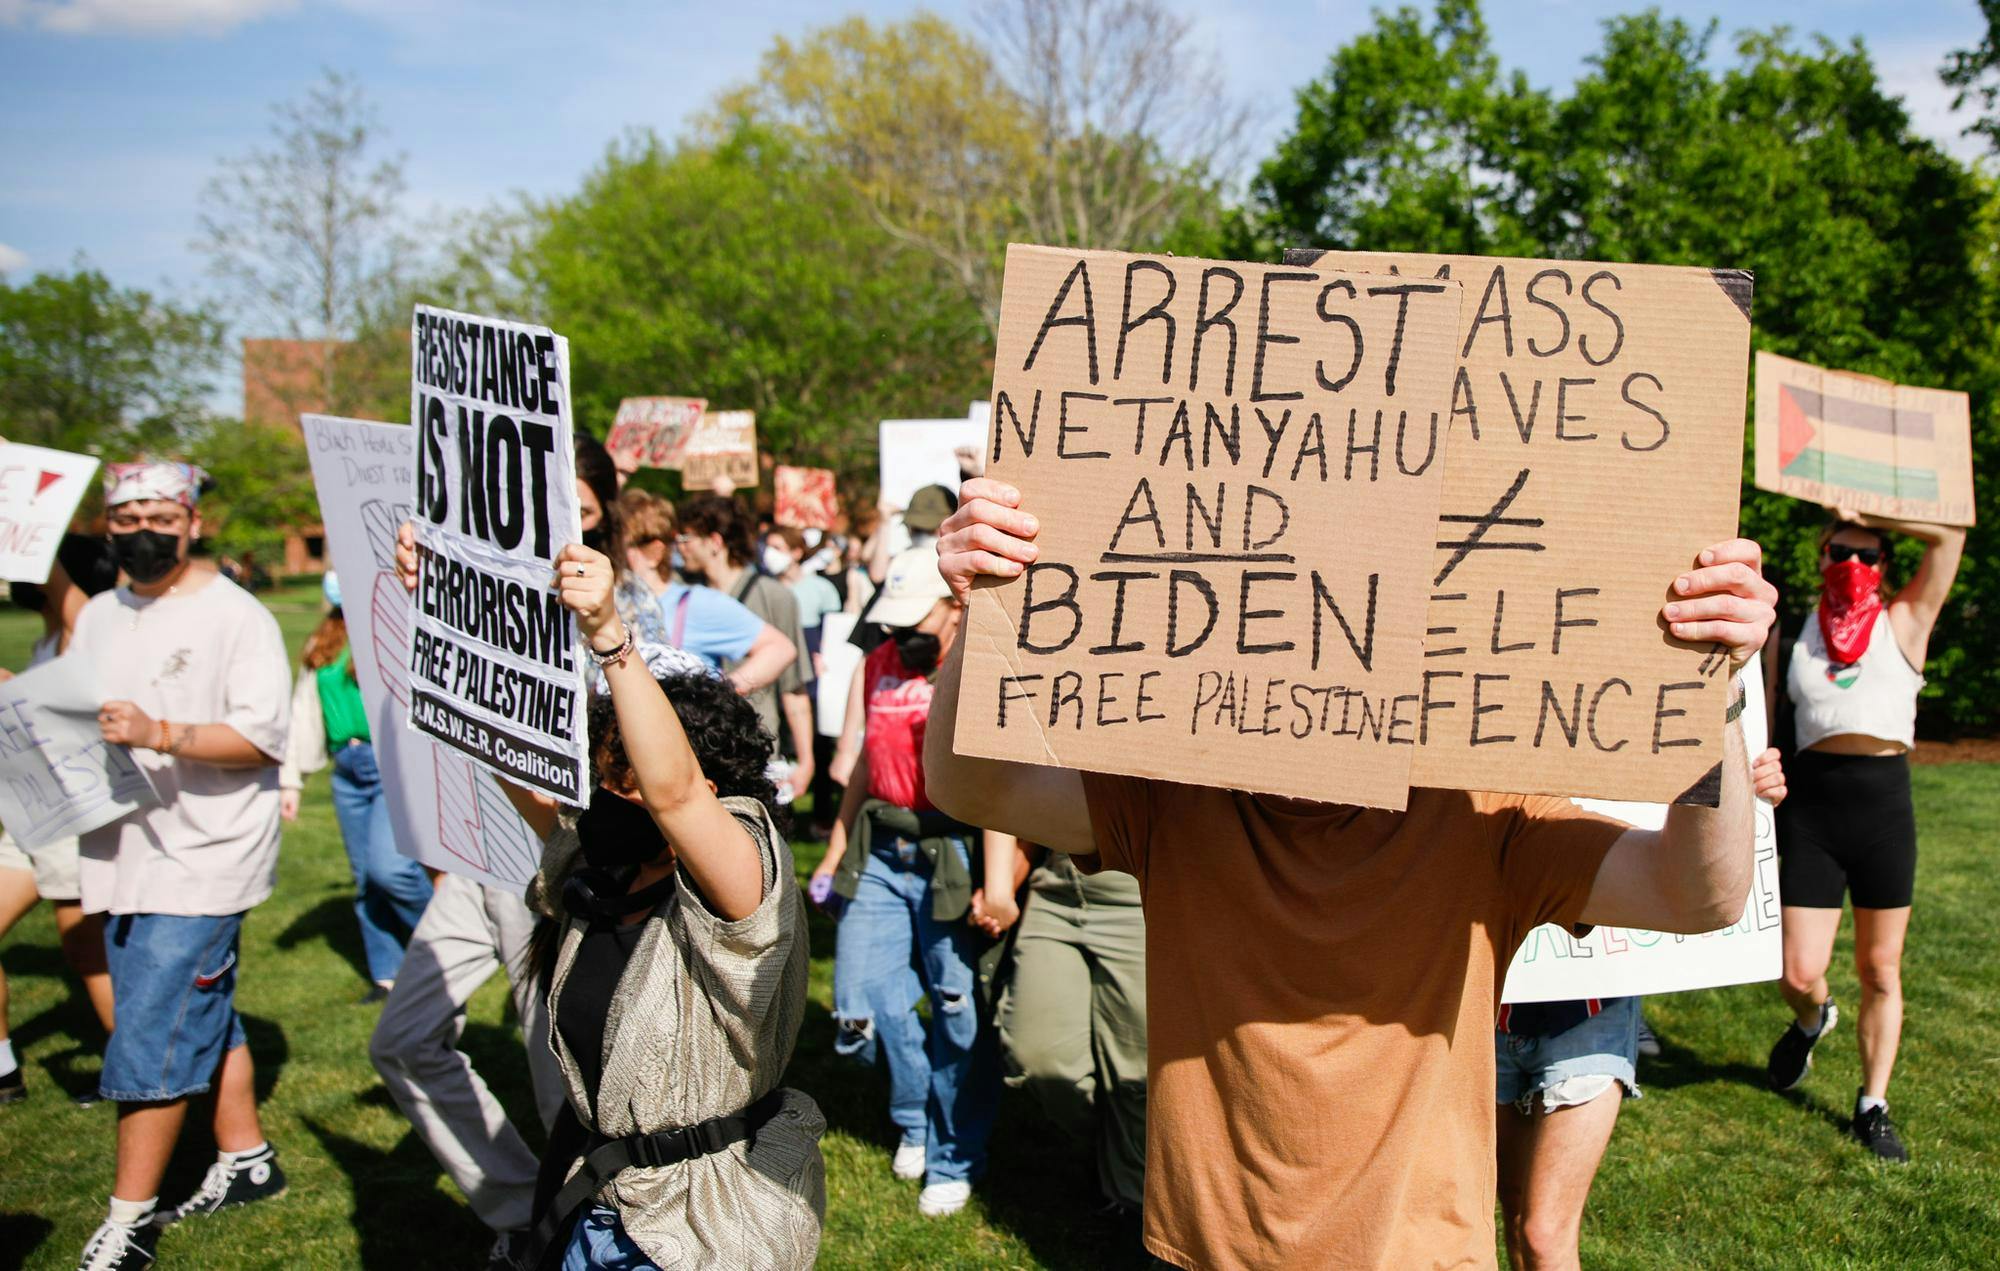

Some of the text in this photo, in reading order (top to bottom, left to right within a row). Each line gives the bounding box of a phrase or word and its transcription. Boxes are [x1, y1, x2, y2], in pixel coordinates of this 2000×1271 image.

[416, 313, 559, 415] RESISTANCE
[1023, 259, 1446, 402] ARREST
[1389, 264, 1625, 366] ASS
[993, 389, 1438, 482] NETANYAHU
[1450, 366, 1671, 452] AVES
[418, 393, 448, 525] IS
[458, 404, 554, 560] NOT
[1108, 477, 1290, 551] AND
[414, 542, 573, 673] TERRORISM!
[1017, 562, 1379, 672] BIDEN
[1423, 588, 1601, 657] ELF
[411, 626, 575, 742] FREE PALESTINE!
[997, 670, 1420, 745] FREE PALESTINE
[494, 736, 576, 791] Coalition
